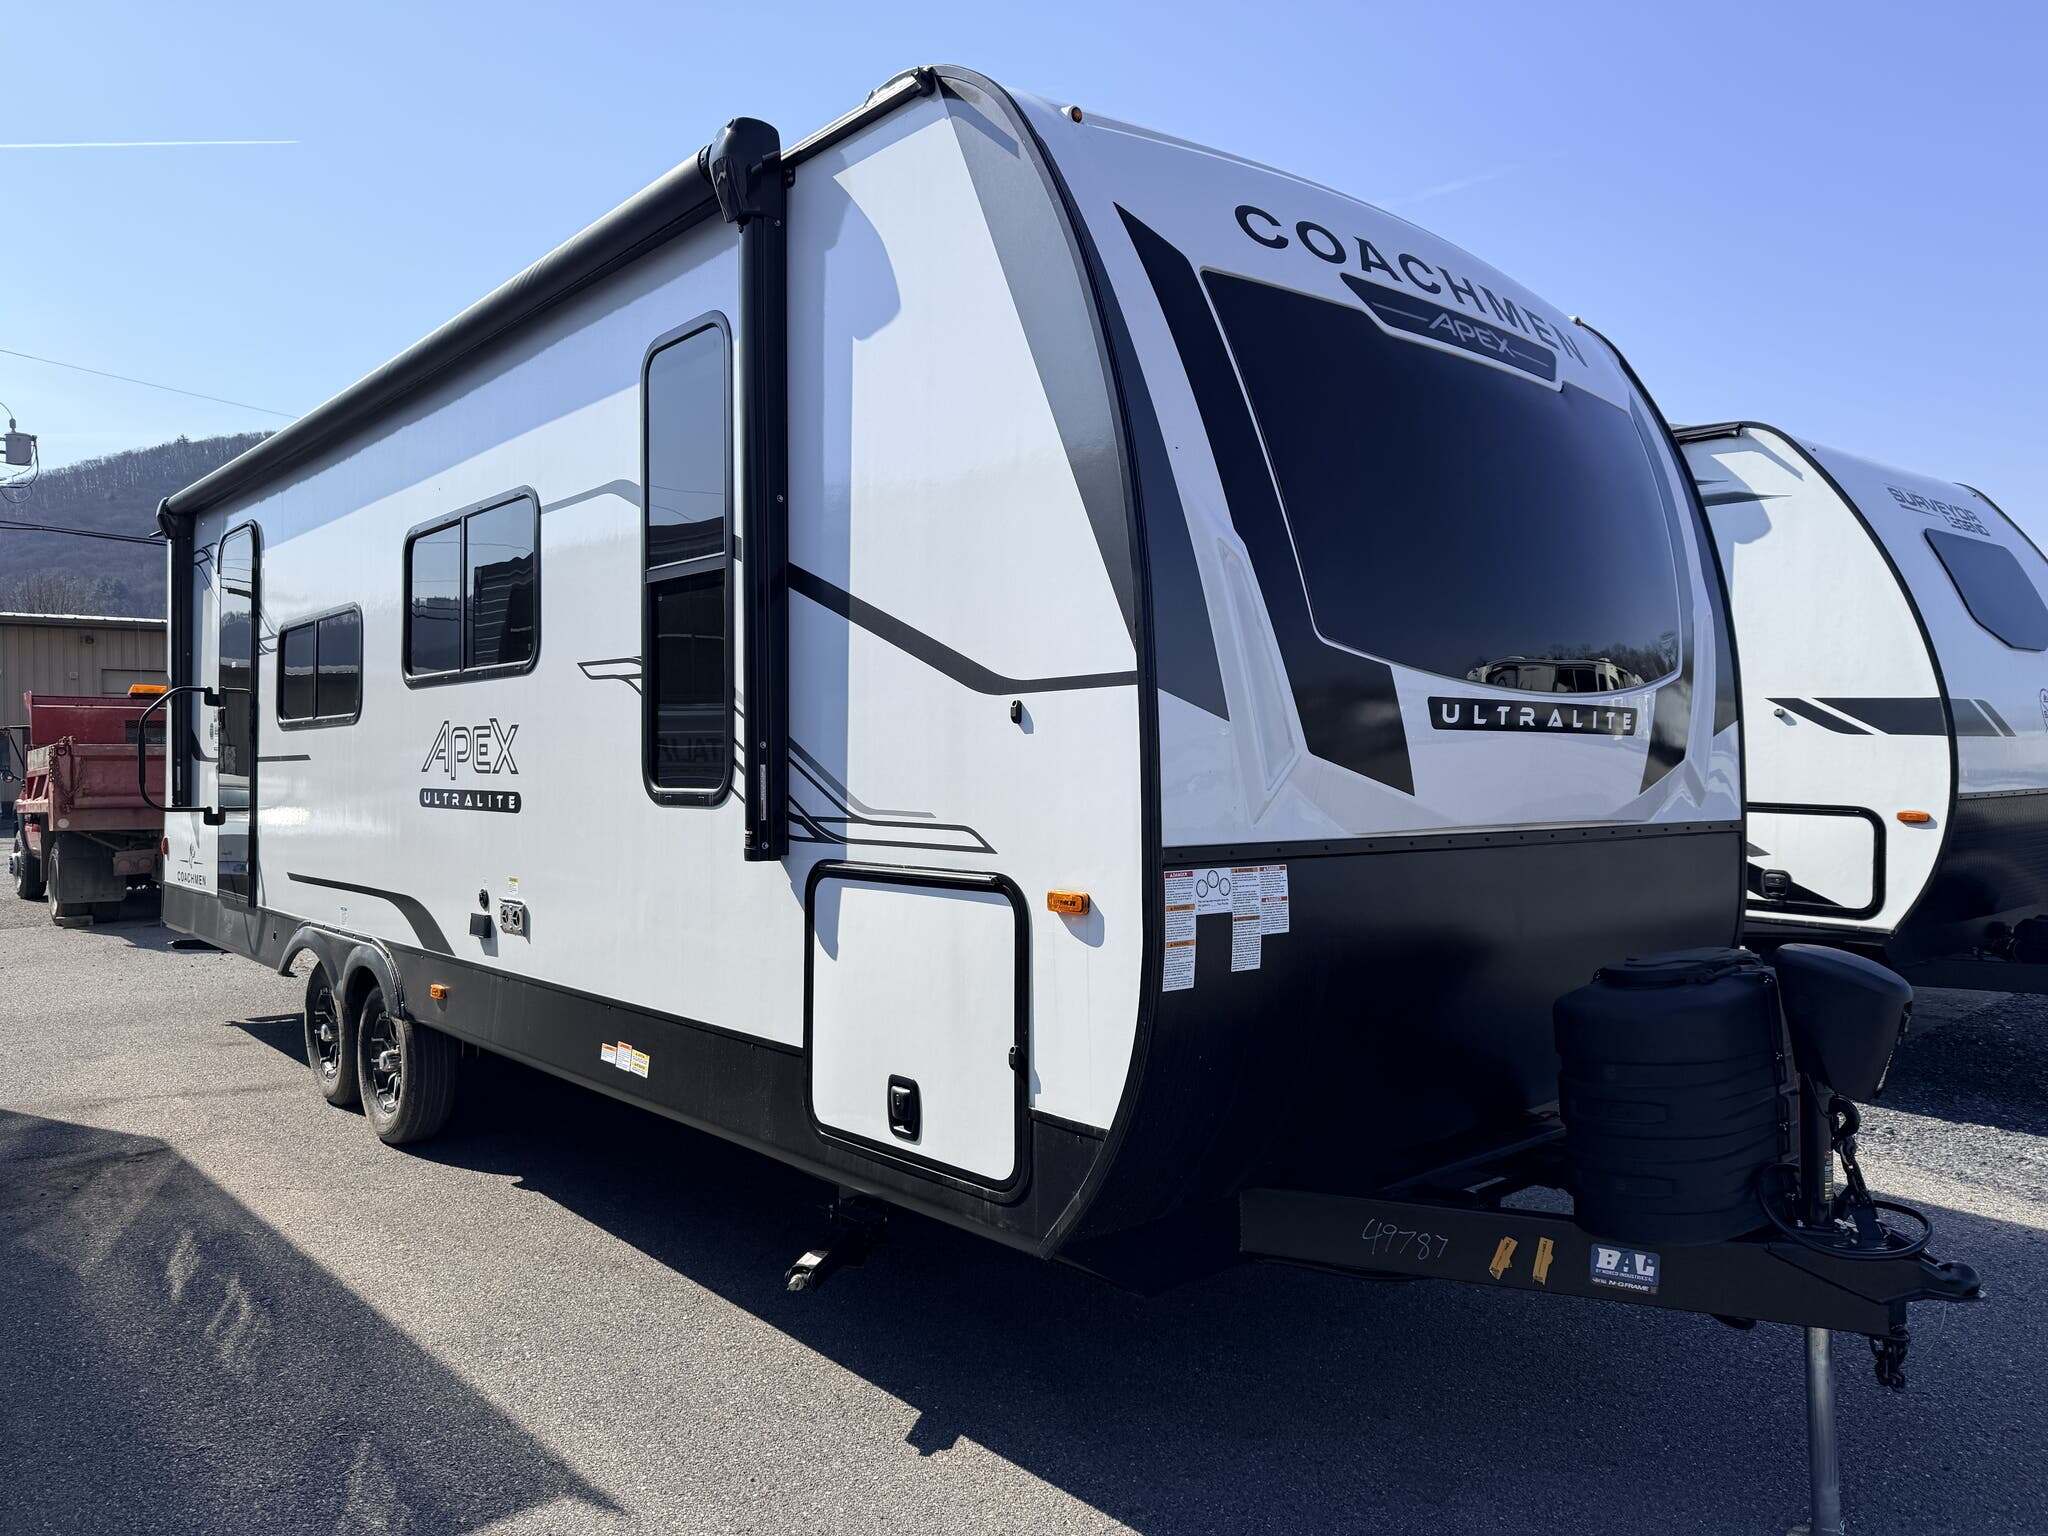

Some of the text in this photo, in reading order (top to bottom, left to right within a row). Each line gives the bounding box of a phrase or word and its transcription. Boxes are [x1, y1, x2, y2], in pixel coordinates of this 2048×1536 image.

[1234, 204, 1588, 368] COACHMEN
[1428, 312, 1516, 357] APEX
[1887, 486, 1982, 524] SURVEYOR
[1441, 703, 1632, 731] ULTRALITE
[421, 718, 519, 780] APEX
[423, 791, 516, 809] ULTRALITE
[177, 870, 207, 886] COACHMEN
[1362, 1219, 1448, 1260] 49787
